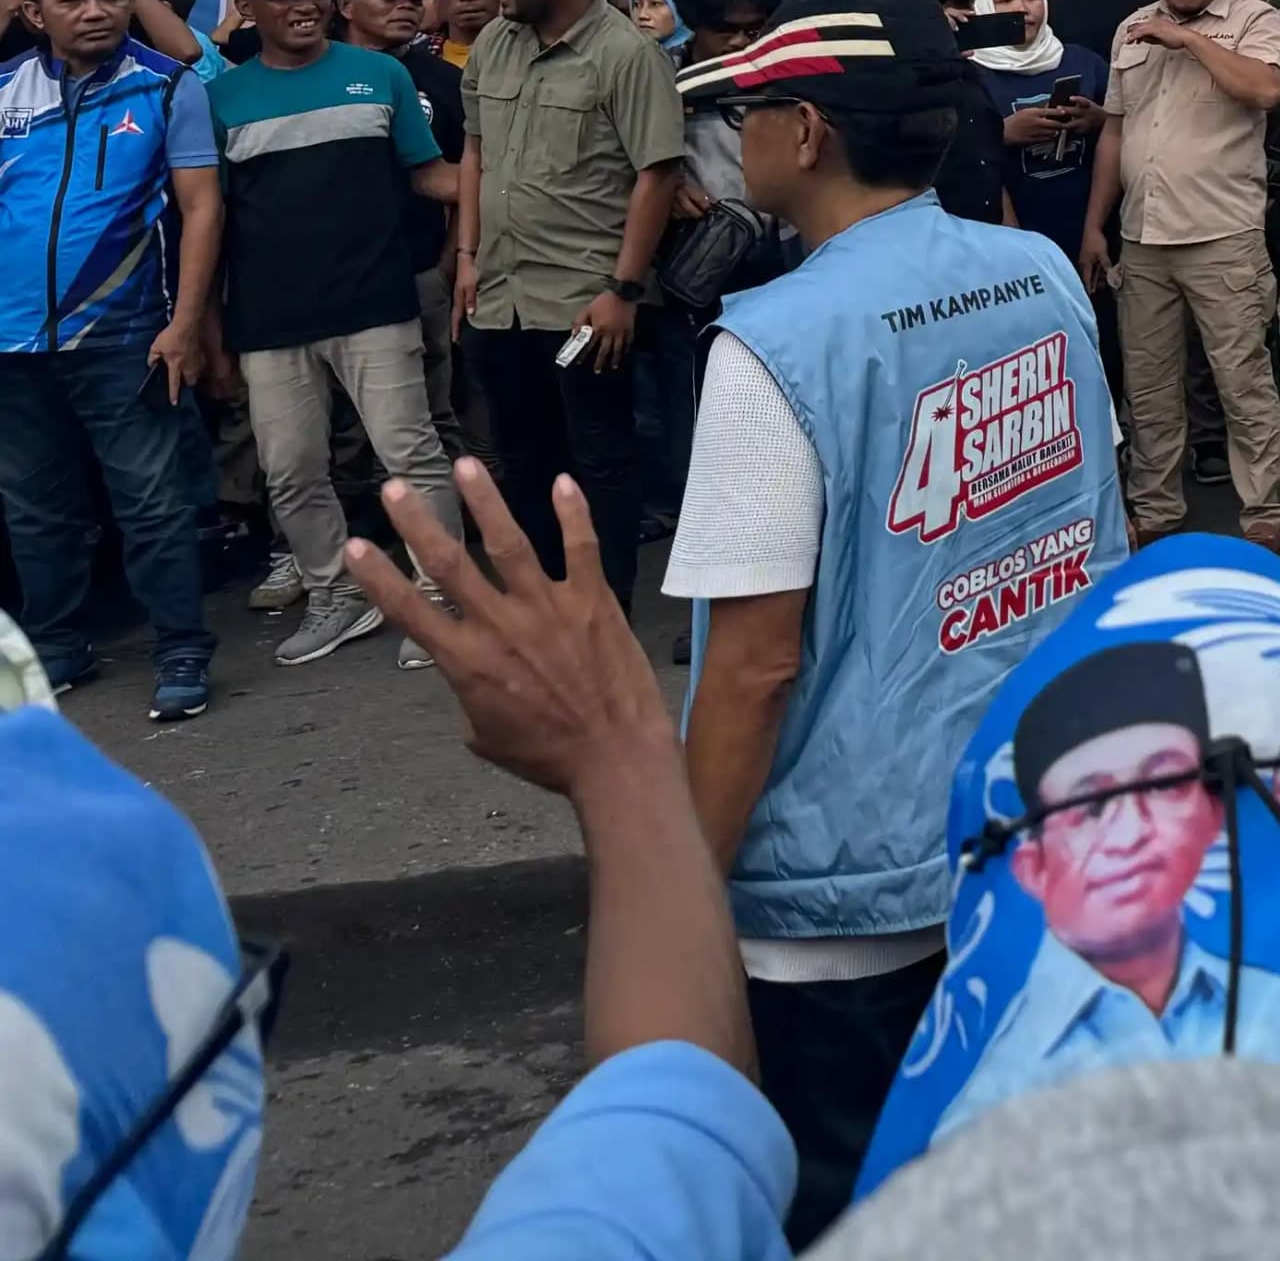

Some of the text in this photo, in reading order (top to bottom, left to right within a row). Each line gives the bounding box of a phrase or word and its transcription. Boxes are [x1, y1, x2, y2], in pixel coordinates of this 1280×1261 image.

[881, 274, 1045, 334] TIM KAMPANYE
[960, 336, 1062, 431] SHERLY
[892, 382, 961, 537] 4
[961, 384, 1071, 483] SARBIN
[970, 467, 1011, 496] BERSAMA
[1011, 451, 1037, 478] MALUT
[938, 520, 1093, 610] COBLOS YANG
[940, 548, 1092, 652] CANTIK
